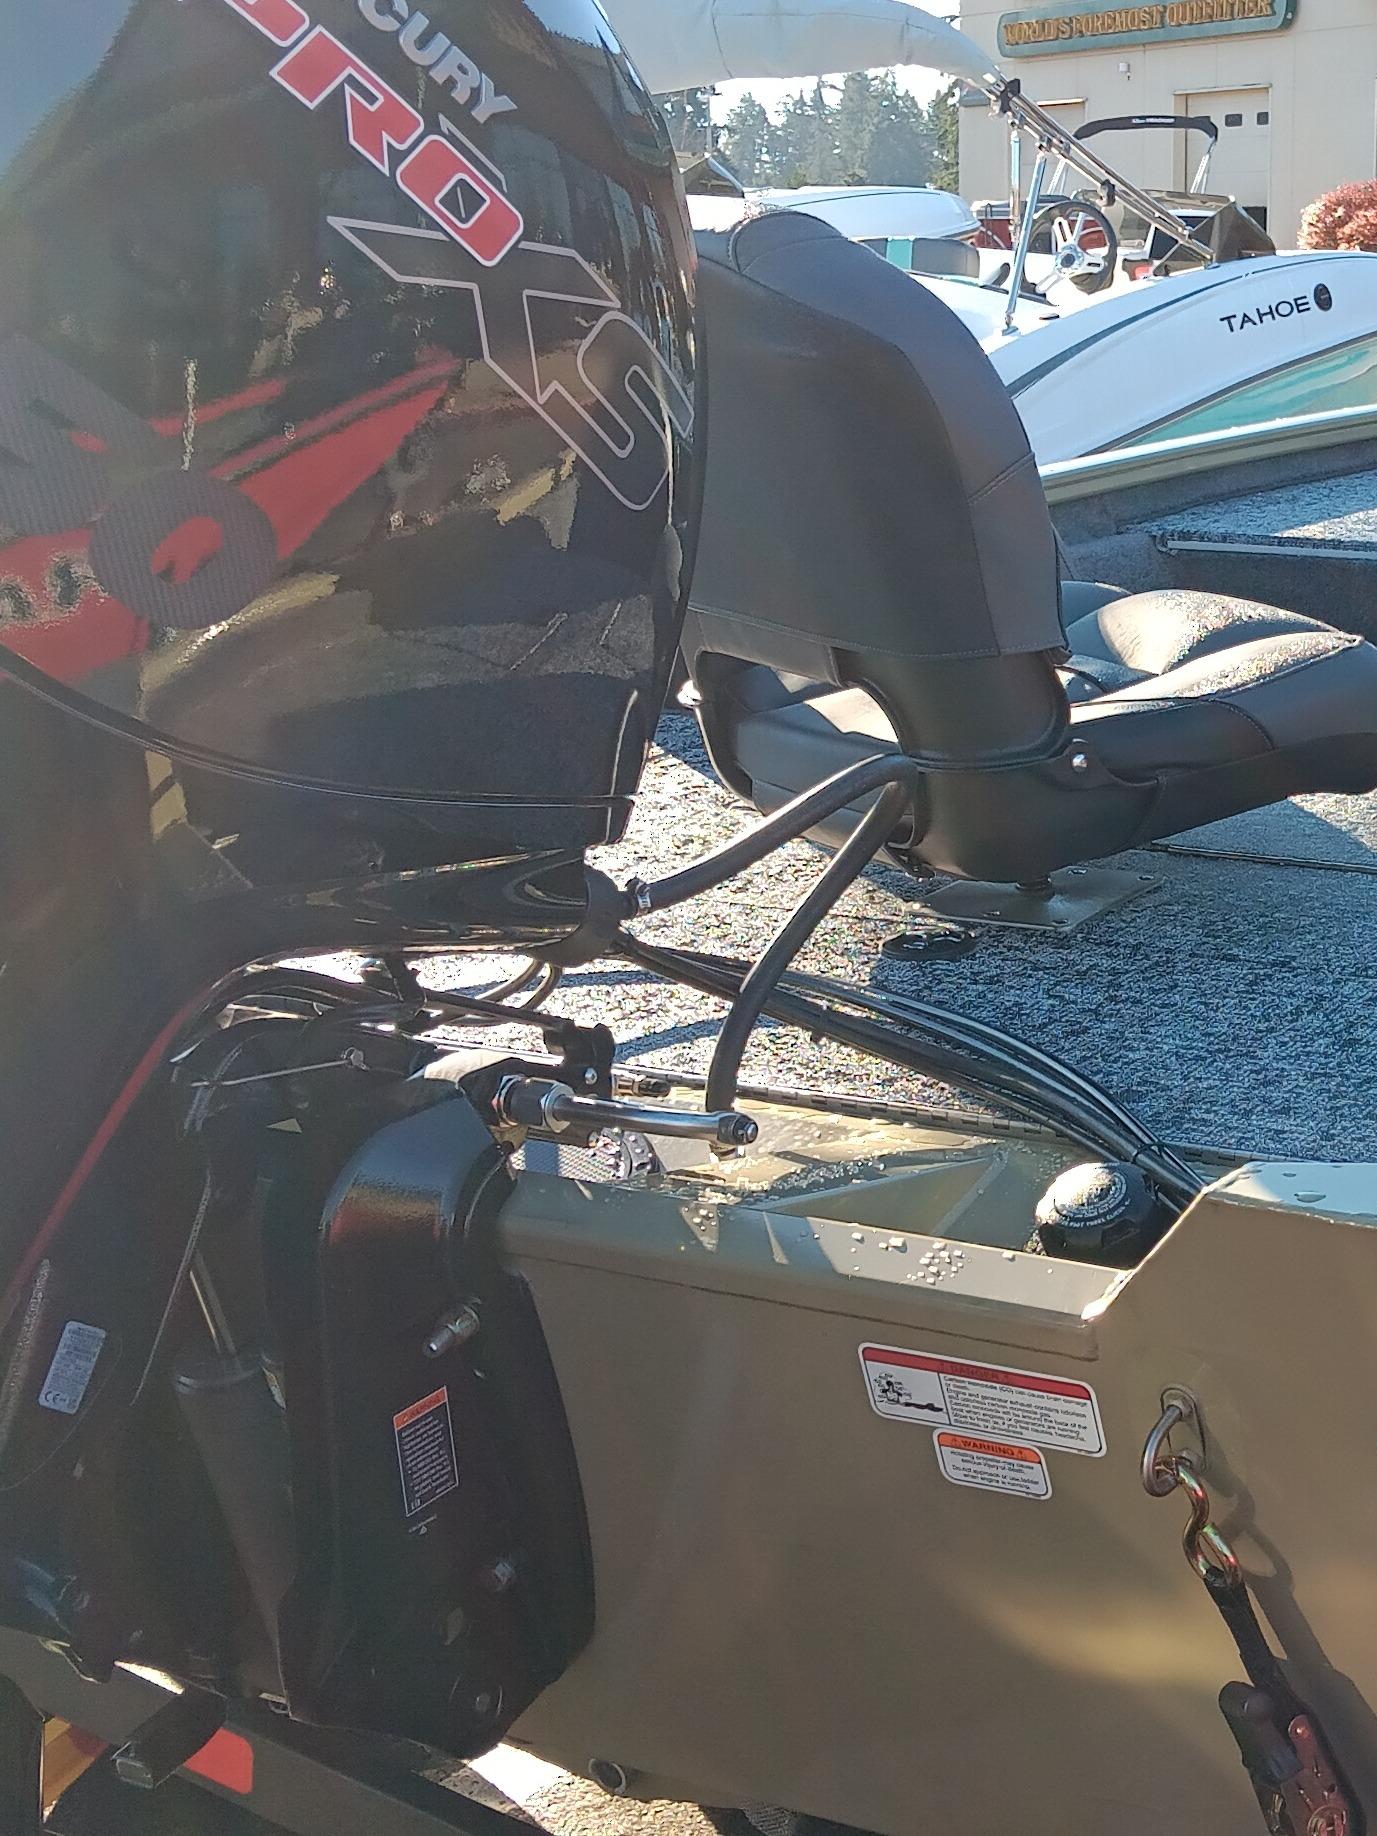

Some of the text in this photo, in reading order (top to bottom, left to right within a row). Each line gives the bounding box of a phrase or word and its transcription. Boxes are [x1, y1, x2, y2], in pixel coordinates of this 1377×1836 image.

[1072, 5, 1164, 39] FOREMOST
[1219, 295, 1311, 332] TAHOE
[961, 1440, 1015, 1456] WARNING
